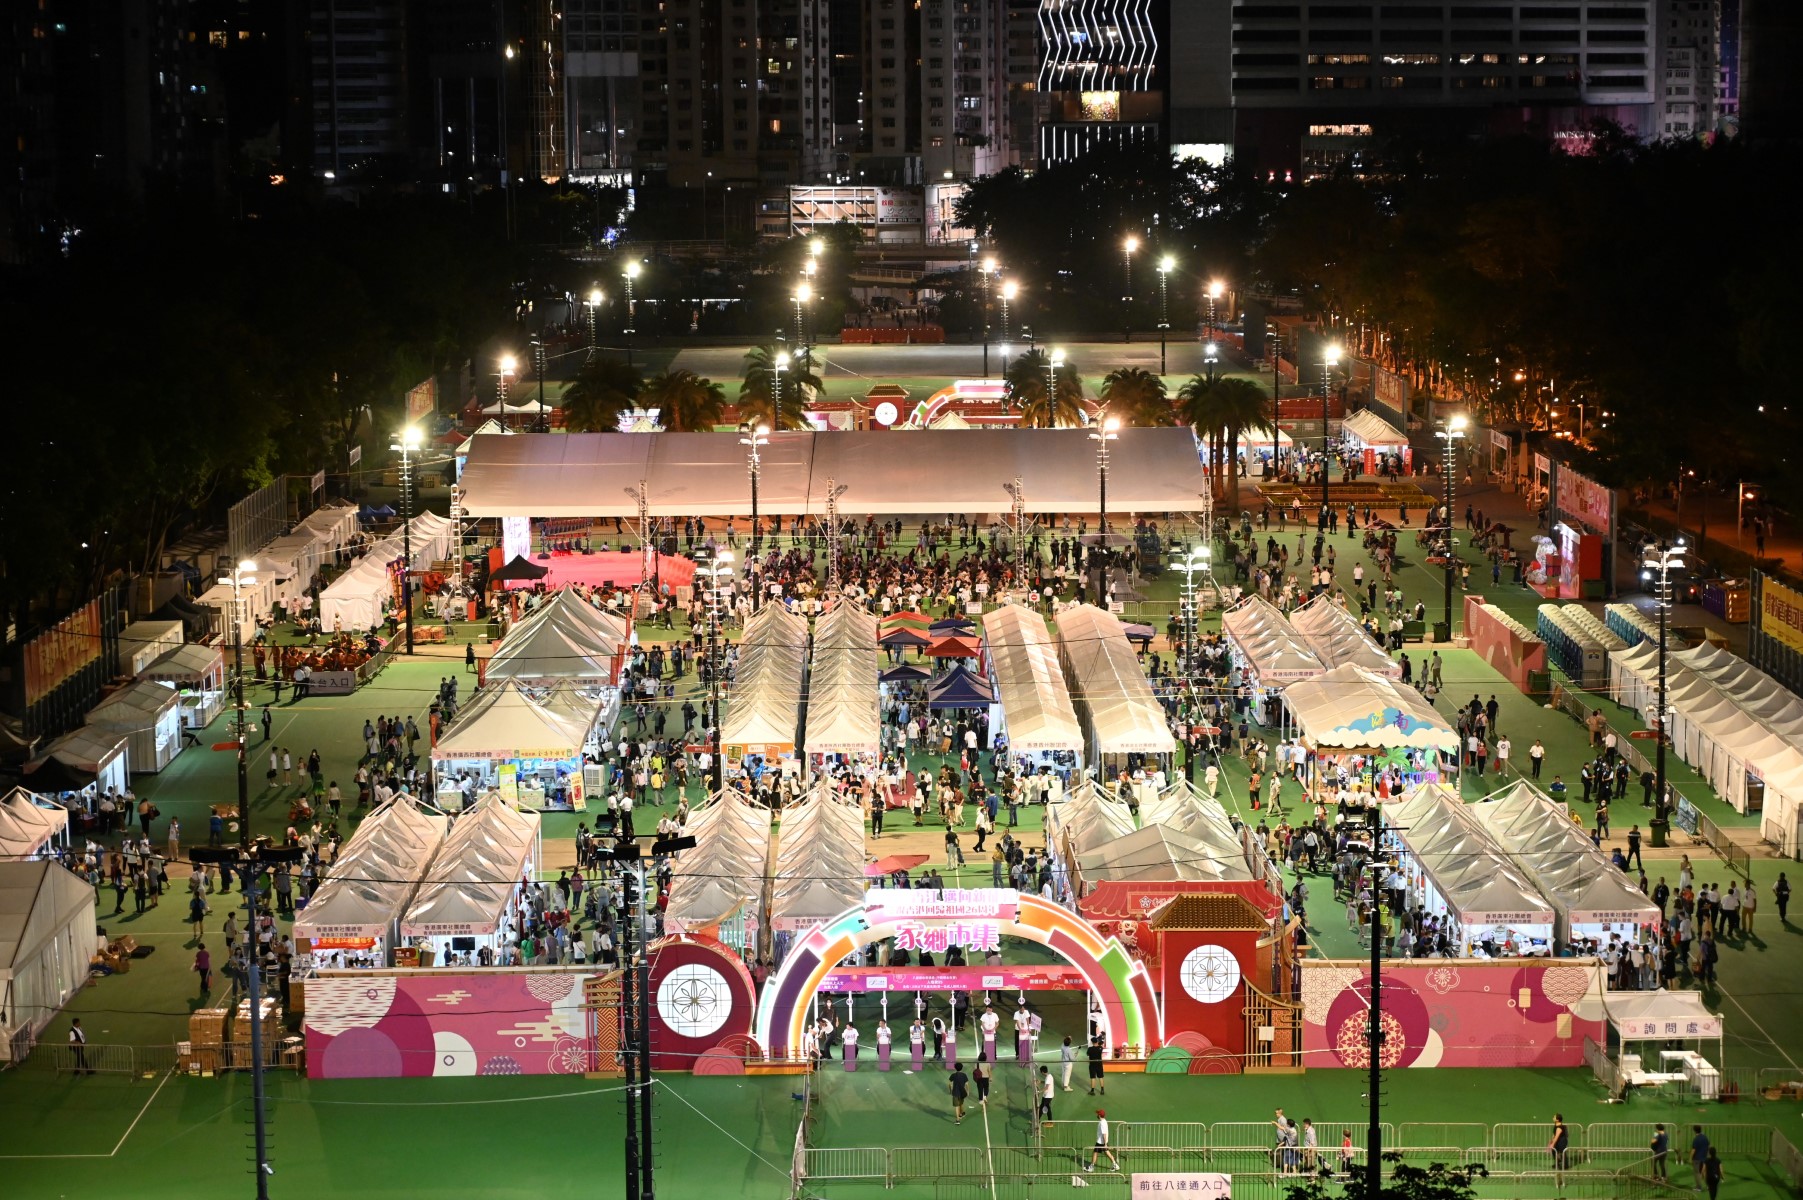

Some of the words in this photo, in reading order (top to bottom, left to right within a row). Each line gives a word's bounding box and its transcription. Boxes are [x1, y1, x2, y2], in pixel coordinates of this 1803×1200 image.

[895, 921, 1000, 953] 家鄉市集
[1644, 1022, 1698, 1035] 詢問處
[1139, 1180, 1223, 1191] 前往八達通入口
